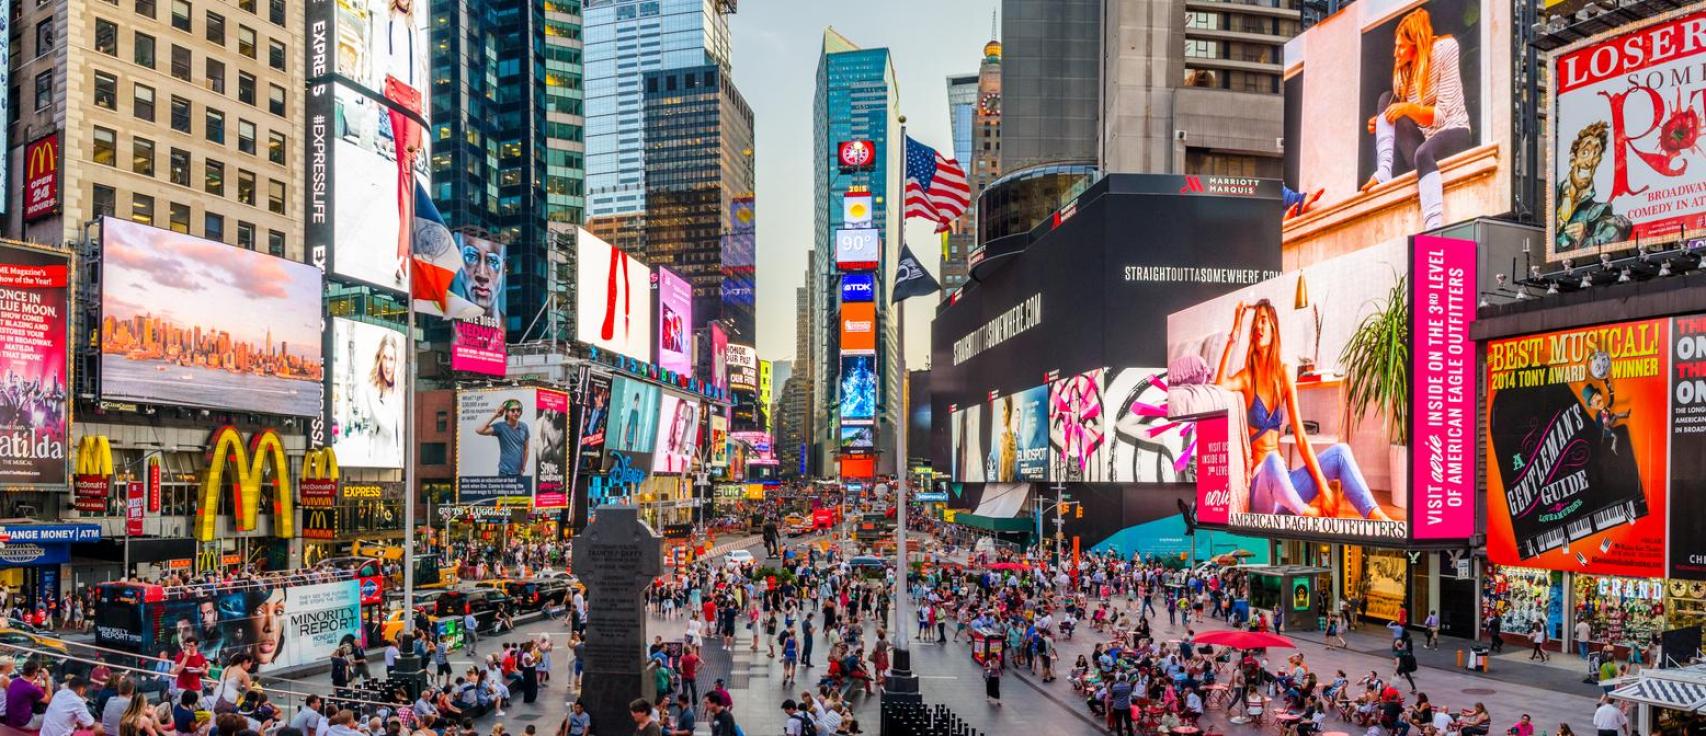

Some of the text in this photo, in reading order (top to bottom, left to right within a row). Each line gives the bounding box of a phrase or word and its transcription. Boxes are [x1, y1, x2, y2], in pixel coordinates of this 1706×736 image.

[313, 20, 326, 97] EXPRES
[313, 114, 326, 223] #EXPRESSLIFE
[31, 174, 53, 189] OPEN
[1209, 177, 1259, 186] MARRIOTT
[1209, 186, 1255, 194] MARQUIS
[33, 184, 49, 203] 24
[27, 197, 55, 214] HOURS
[1628, 201, 1673, 219] COMEDY
[1676, 198, 1688, 210] IN
[0, 288, 41, 304] ONCE IN
[22, 303, 57, 318] MOON,
[34, 323, 48, 331] AND
[1491, 322, 1660, 372] BEST MUSICAL!
[1491, 357, 1659, 390] 2014 TONY AWARD WINNER
[1424, 248, 1444, 526] VISIT aerie INSIDE ON THE 3RD LEVEL
[1447, 267, 1464, 507] OF AMERICAN EAGLE OUTFITTERS
[1675, 425, 1682, 434] IN
[1208, 441, 1221, 453] VISIT
[1202, 453, 1226, 464] INSIDE ON
[1507, 402, 1584, 517] GENTLEMAN'S
[1512, 453, 1525, 471] A
[344, 486, 381, 497] EXPRESS
[1540, 469, 1590, 506] GUIDE
[40, 529, 100, 539] MONEY ATM
[1229, 513, 1407, 538] AMERICAN EAGLE OUTFITTERS
[1600, 576, 1662, 600] GRAND
[291, 607, 356, 625] MINORITY
[299, 616, 357, 636] REPORT
[101, 631, 129, 641] REPORT
